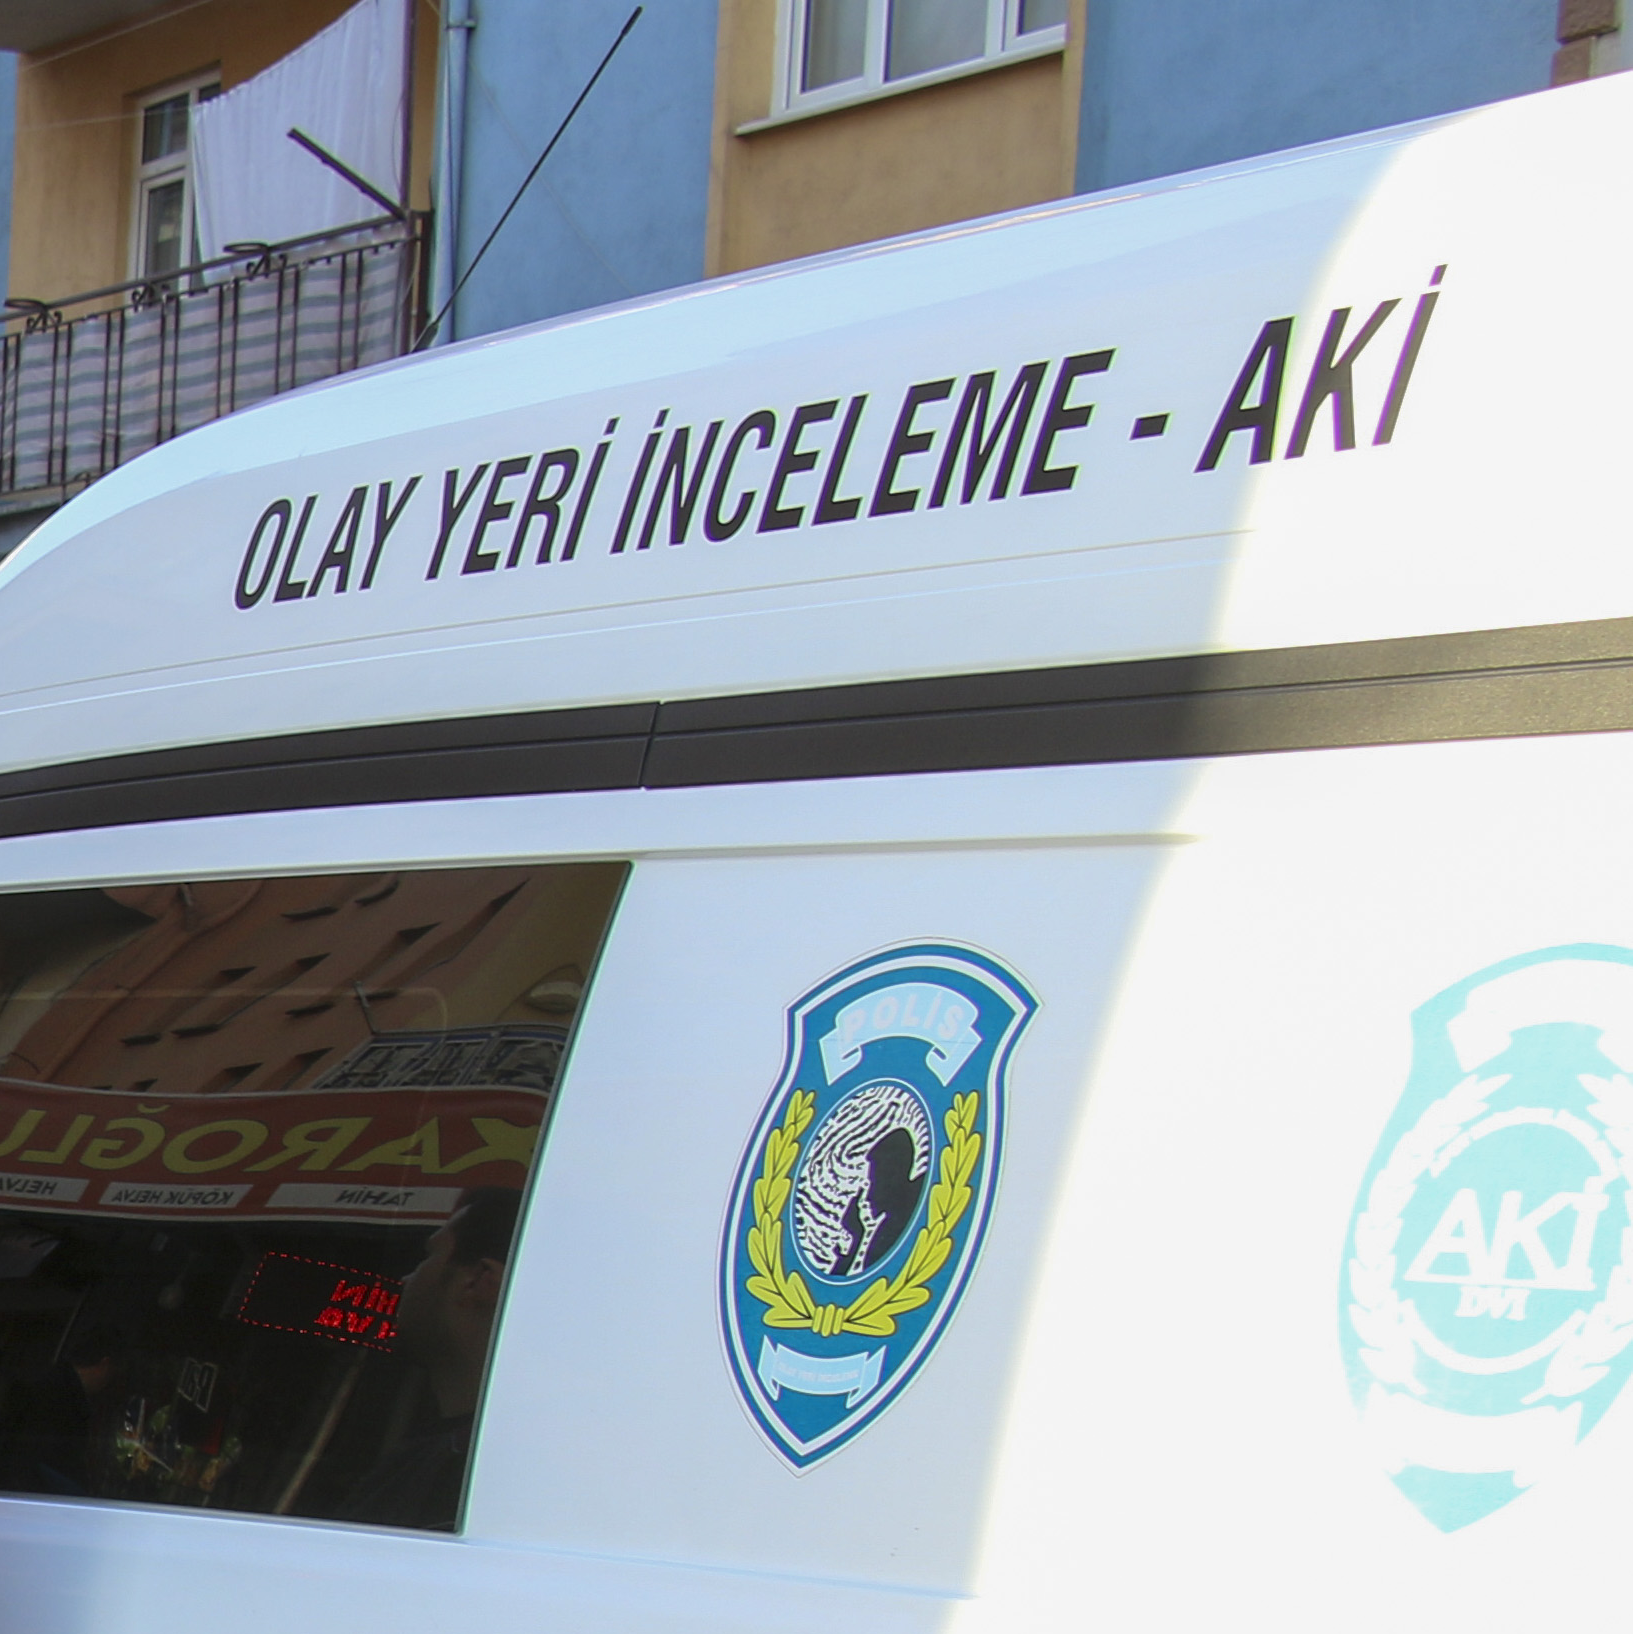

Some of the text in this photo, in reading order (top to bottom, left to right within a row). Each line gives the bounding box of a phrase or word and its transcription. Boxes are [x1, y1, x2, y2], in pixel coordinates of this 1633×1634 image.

[234, 474, 422, 611] OLAY
[425, 416, 621, 581] YERİ
[609, 348, 1117, 555] İNCELEME
[1193, 263, 1448, 474] AKİ
[842, 991, 966, 1050] POLİS
